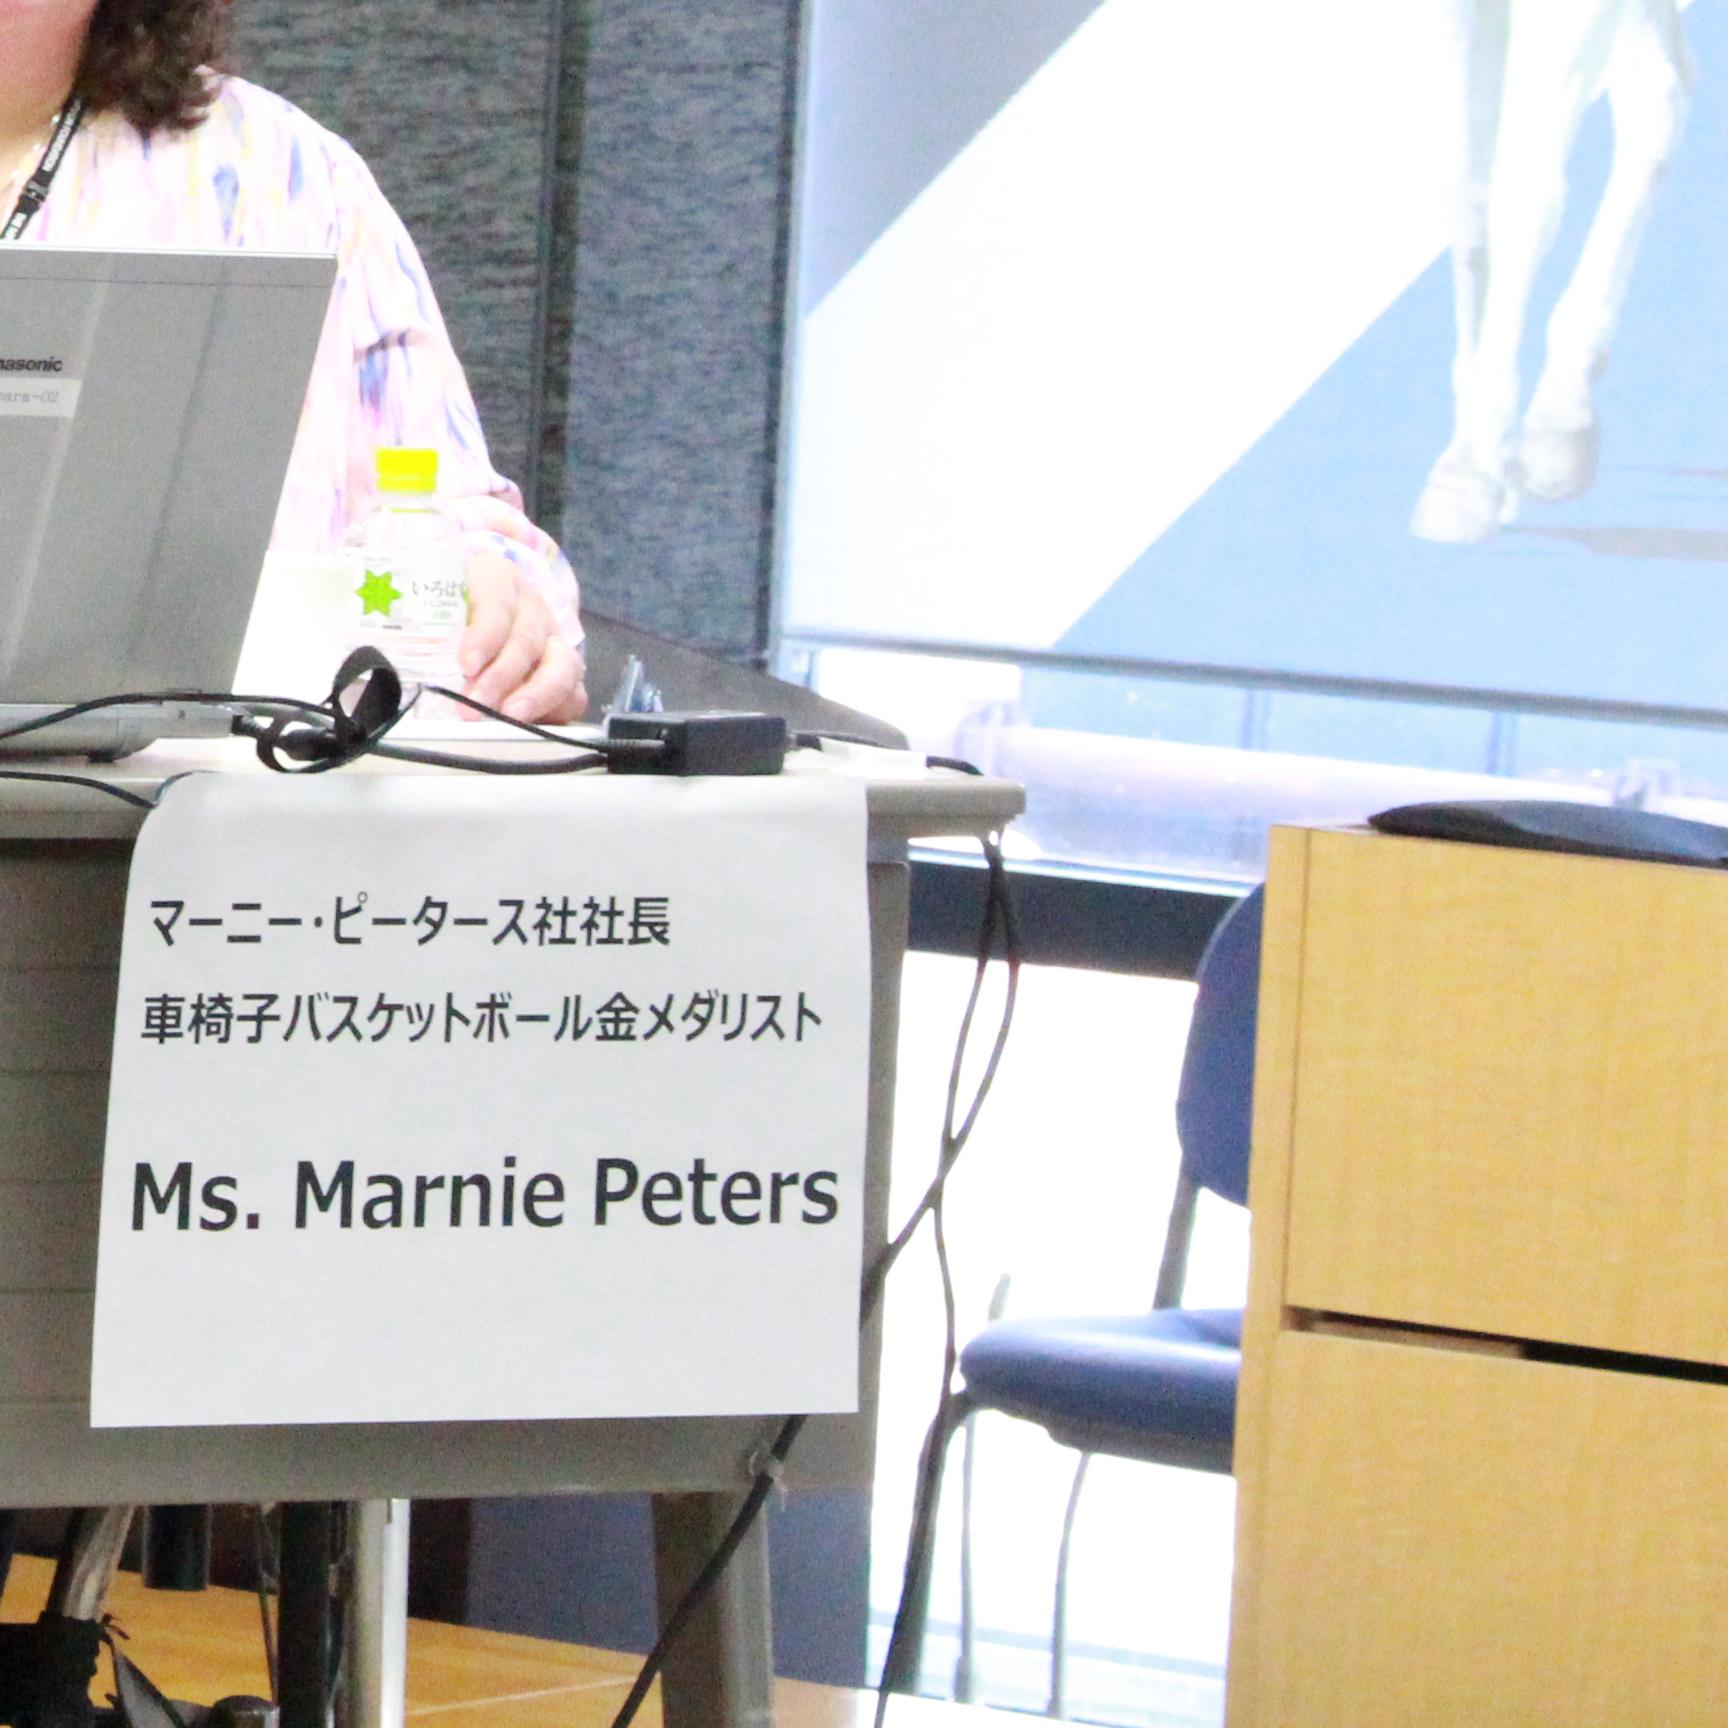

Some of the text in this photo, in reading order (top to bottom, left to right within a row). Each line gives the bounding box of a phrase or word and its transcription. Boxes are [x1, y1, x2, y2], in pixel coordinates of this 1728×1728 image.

[141, 991, 823, 1046] 車椅子バスケットボール金メダリスト
[131, 1155, 838, 1232] Ms. Marnie Peters
